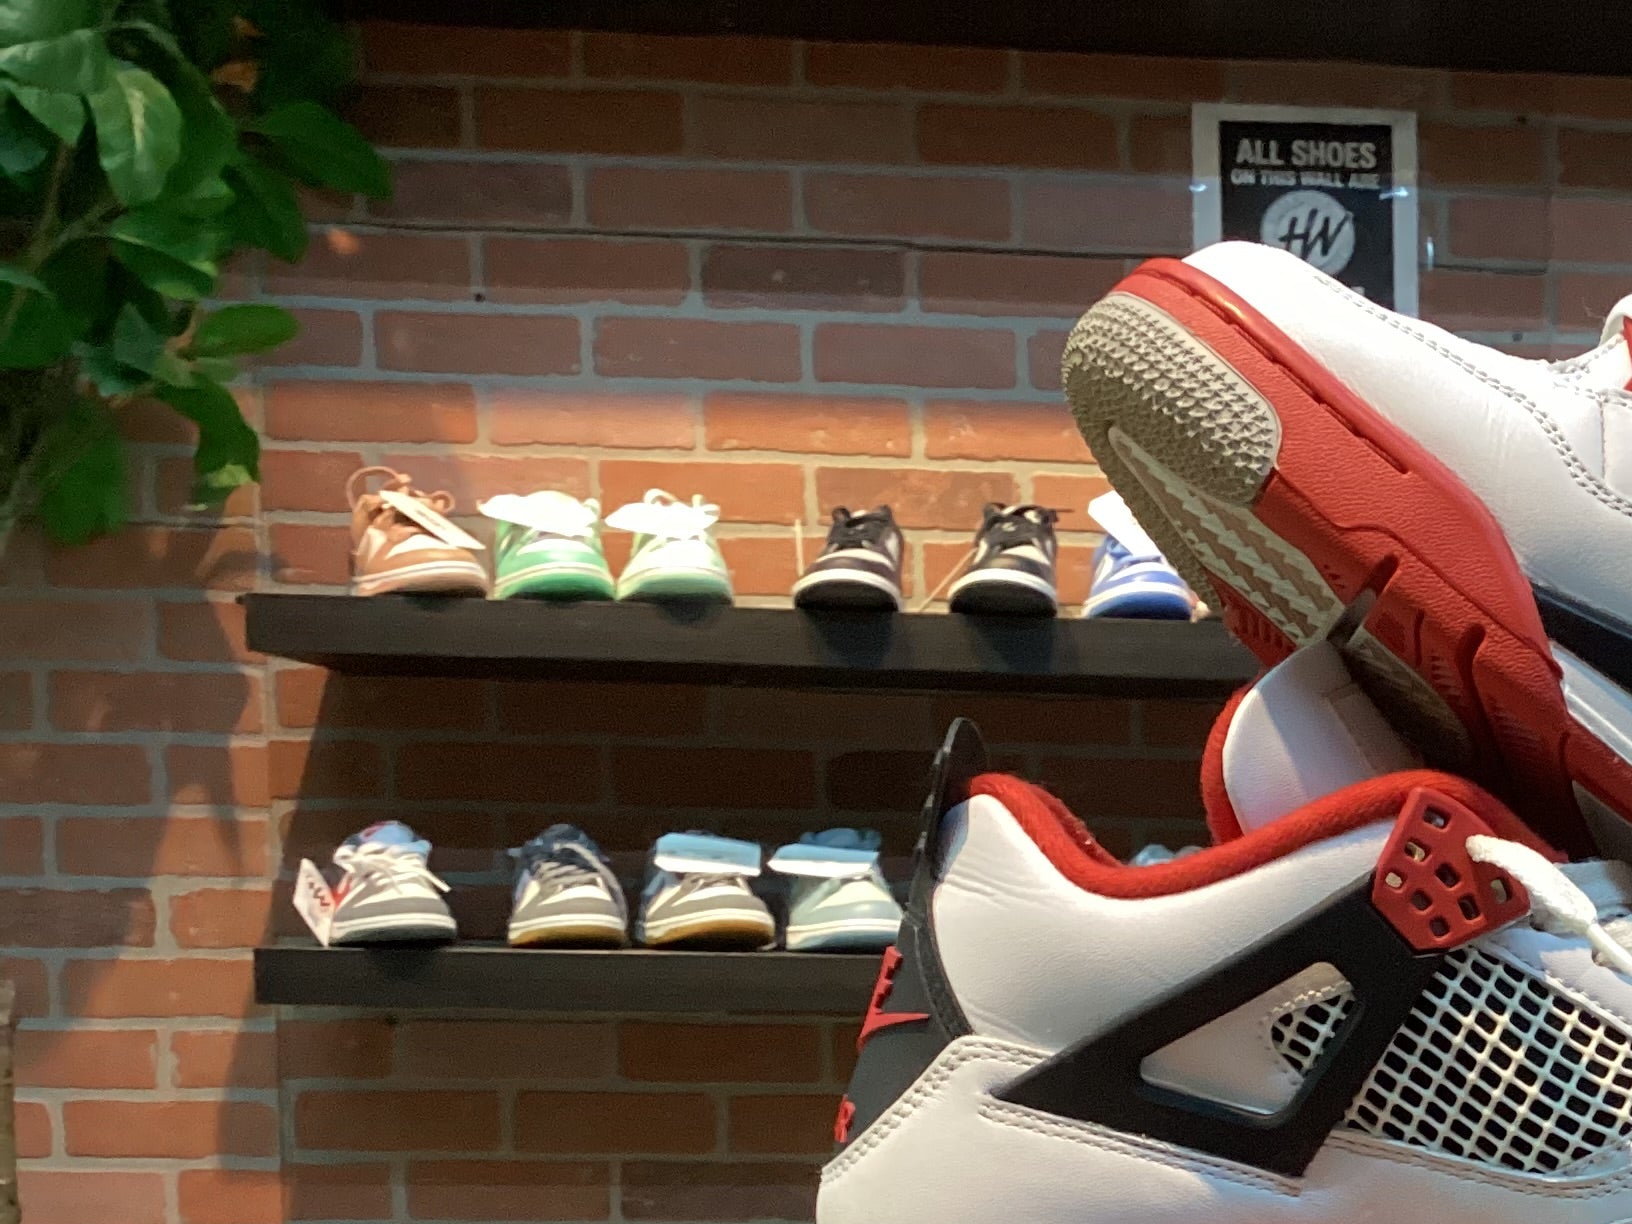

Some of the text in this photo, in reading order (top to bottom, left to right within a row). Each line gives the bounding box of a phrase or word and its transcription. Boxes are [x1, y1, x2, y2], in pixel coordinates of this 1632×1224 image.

[1235, 137, 1378, 169] ALL SHOES
[1230, 168, 1256, 185] ON
